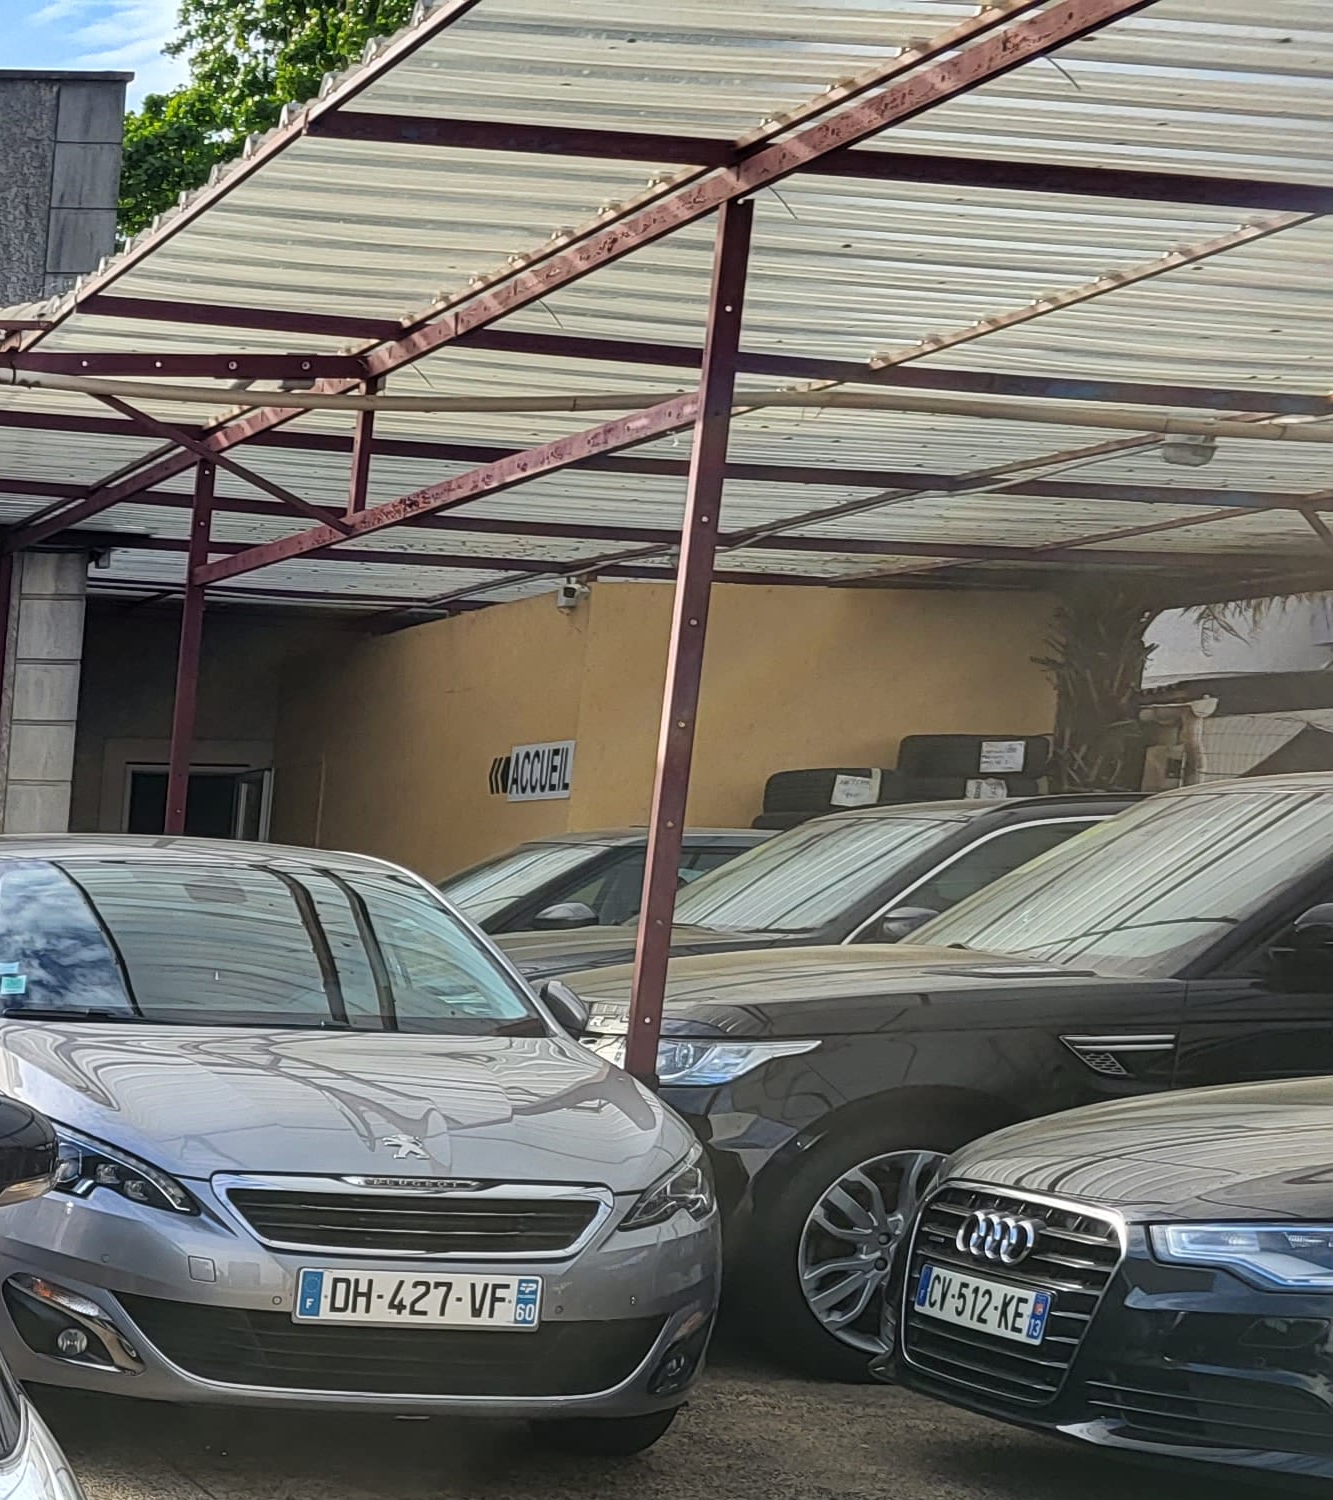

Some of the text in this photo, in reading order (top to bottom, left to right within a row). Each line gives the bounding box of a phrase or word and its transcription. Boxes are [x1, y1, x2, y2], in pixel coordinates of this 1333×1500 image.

[509, 747, 569, 794] ACCUEIL
[305, 1277, 535, 1320] F DH-427-VF 60
[929, 1274, 1029, 1334] CV-512-KE
[1028, 1319, 1042, 1337] 13
